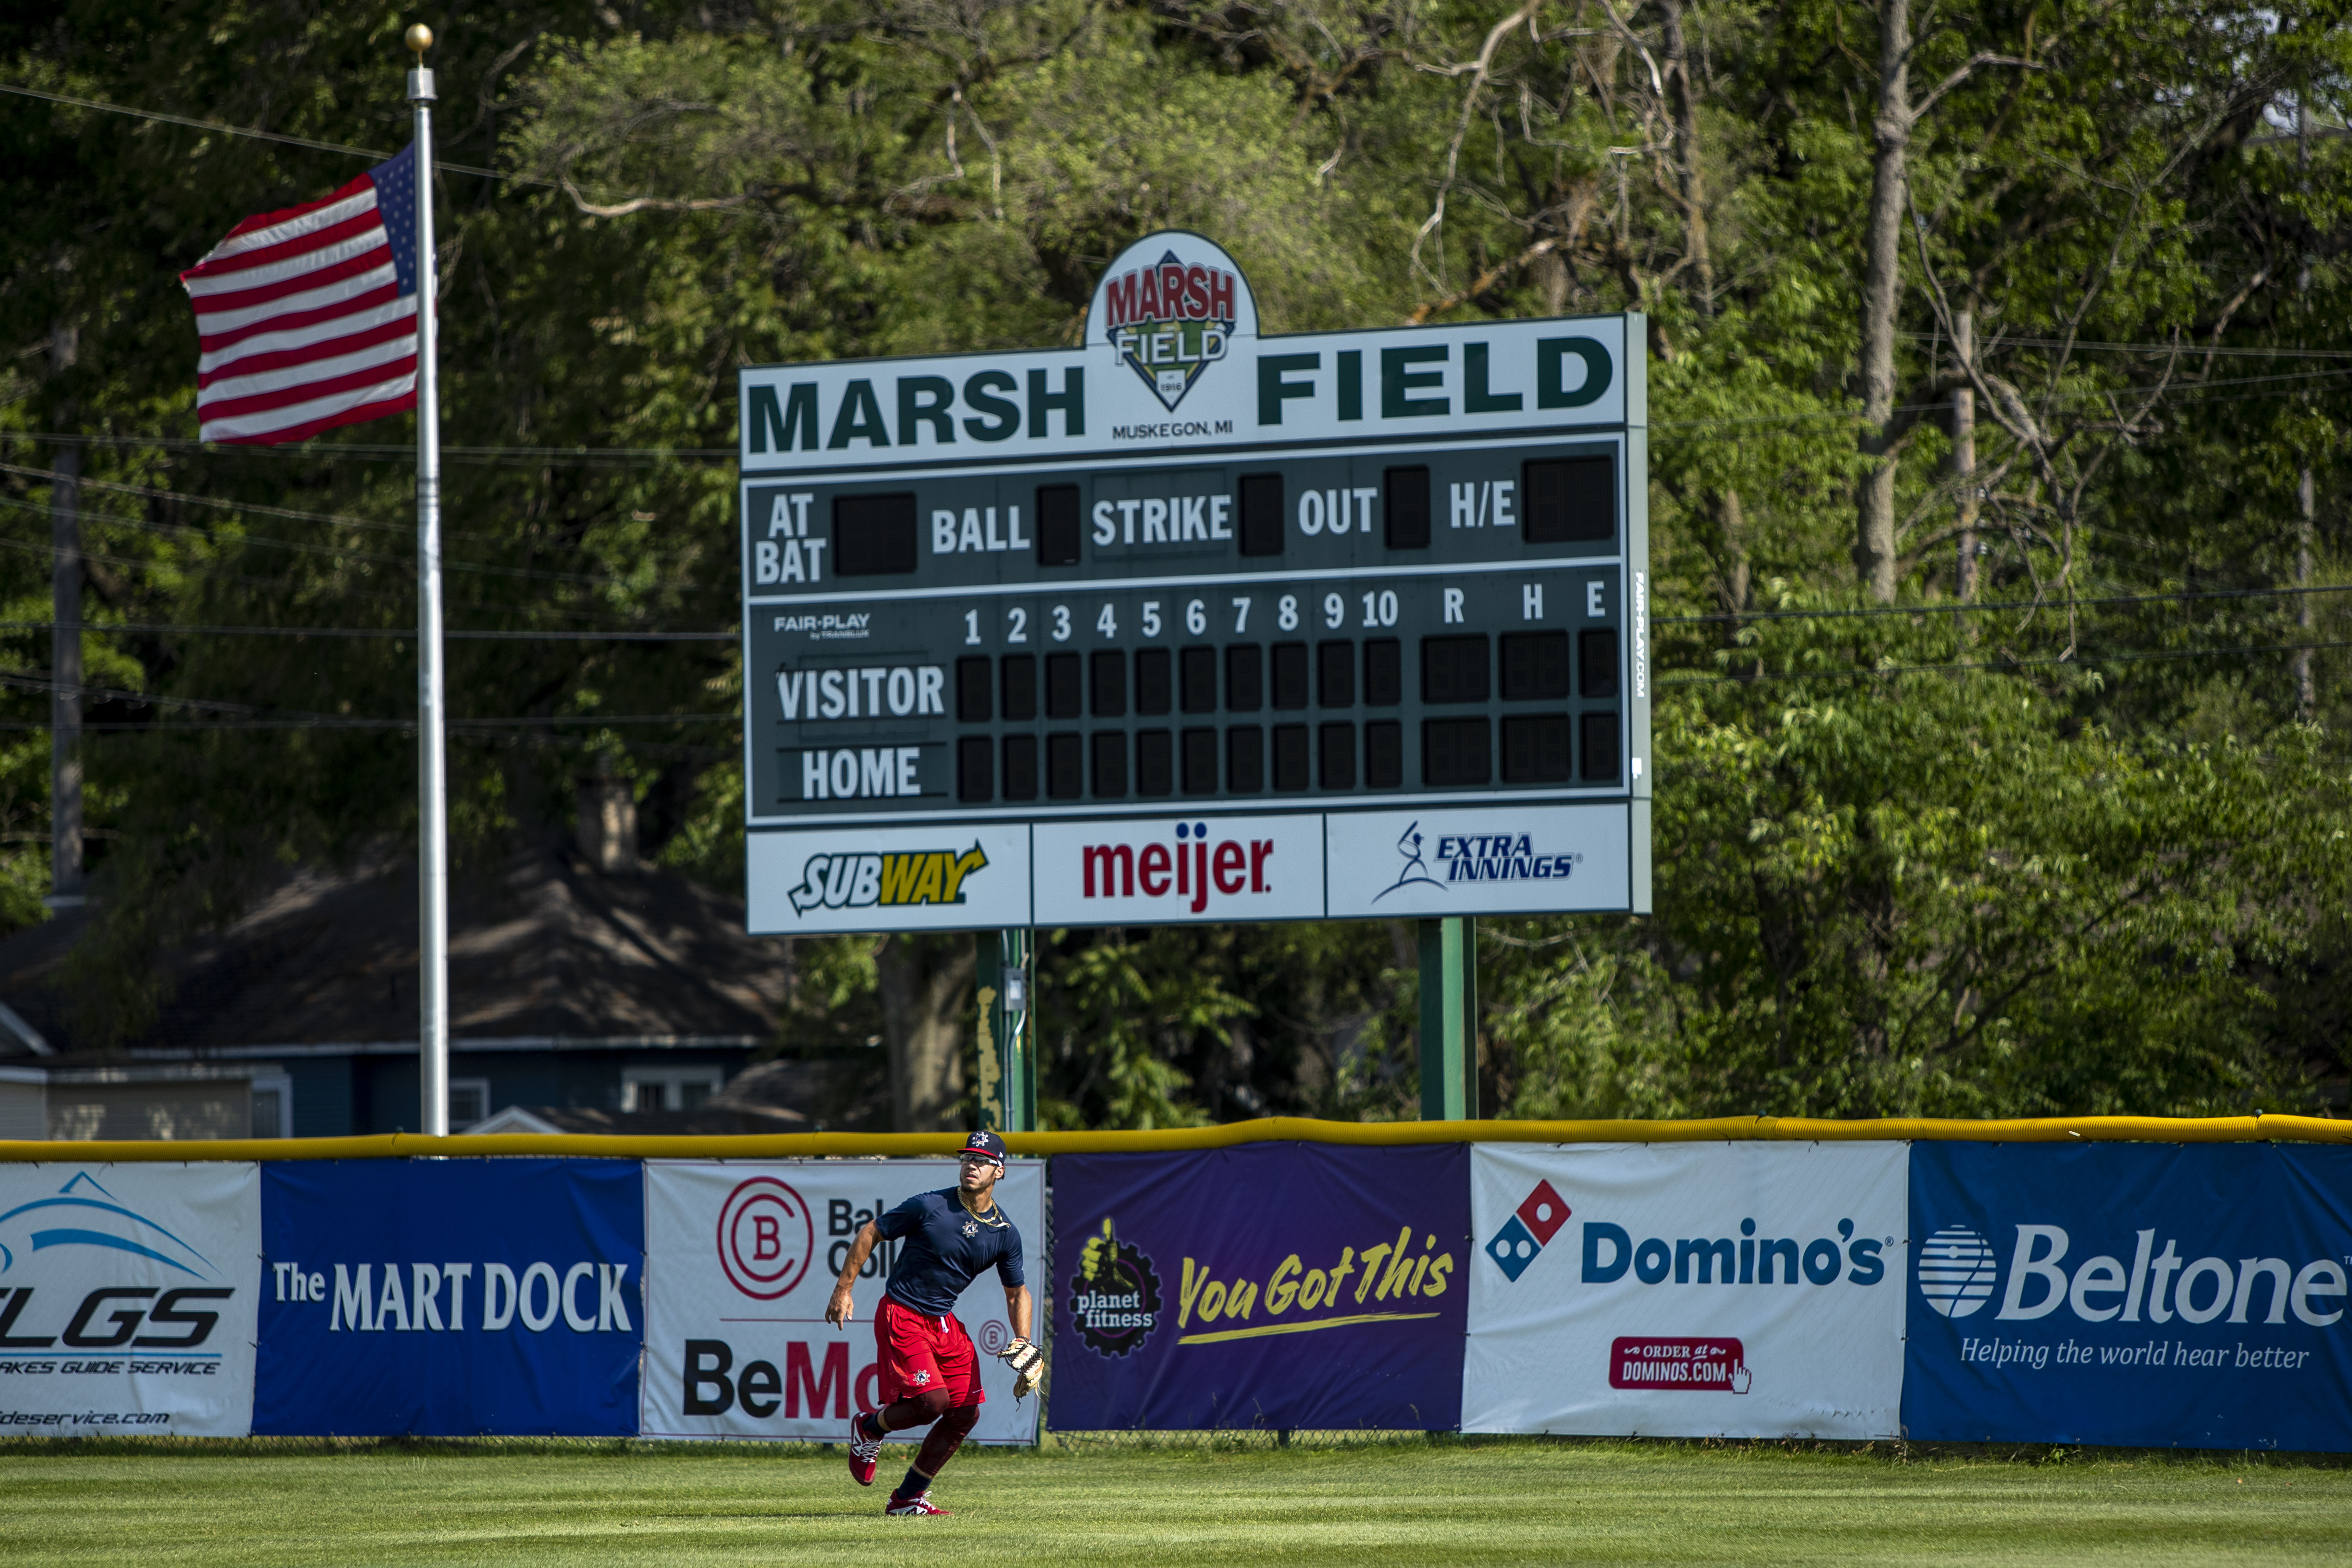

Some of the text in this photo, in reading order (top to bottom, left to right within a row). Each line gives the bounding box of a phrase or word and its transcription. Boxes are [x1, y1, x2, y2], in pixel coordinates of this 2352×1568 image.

[1106, 262, 1237, 328] MARSH
[1114, 329, 1228, 366] FIELD
[748, 335, 1614, 454] MARSH FIELD
[1113, 420, 1233, 439] MUSKEGON, MI
[769, 492, 814, 538] AT
[1092, 495, 1233, 546] STRIKE
[1298, 487, 1378, 536] OUT
[1450, 480, 1516, 528] H/E
[932, 505, 1030, 554] BALL
[755, 538, 827, 585] BAT
[964, 581, 1605, 645] 1 2 3 4 5 6 7 8 9 10 R H E
[1635, 572, 1645, 698] FAIR-PLAY.COM
[777, 665, 945, 720] VISITOR
[802, 747, 921, 799] HOME
[1436, 833, 1533, 861] EXTRA
[1446, 854, 1574, 883] INNINGS
[787, 837, 989, 918] SUBWAY
[1581, 1217, 1885, 1286] Domino's
[1994, 1224, 2347, 1326] Beltone
[273, 1261, 632, 1332] The MART DOCK
[1178, 1226, 1453, 1328] You Got This
[1077, 1290, 1140, 1314] planet
[1085, 1309, 1153, 1327] fitness
[60, 1361, 125, 1375] GUIDE
[127, 1361, 221, 1375] SERVICE
[1622, 1361, 1727, 1382] DOMINOS.COM
[1643, 1344, 1708, 1358] ORDER at
[1960, 1337, 2310, 1369] Helping the world hear better
